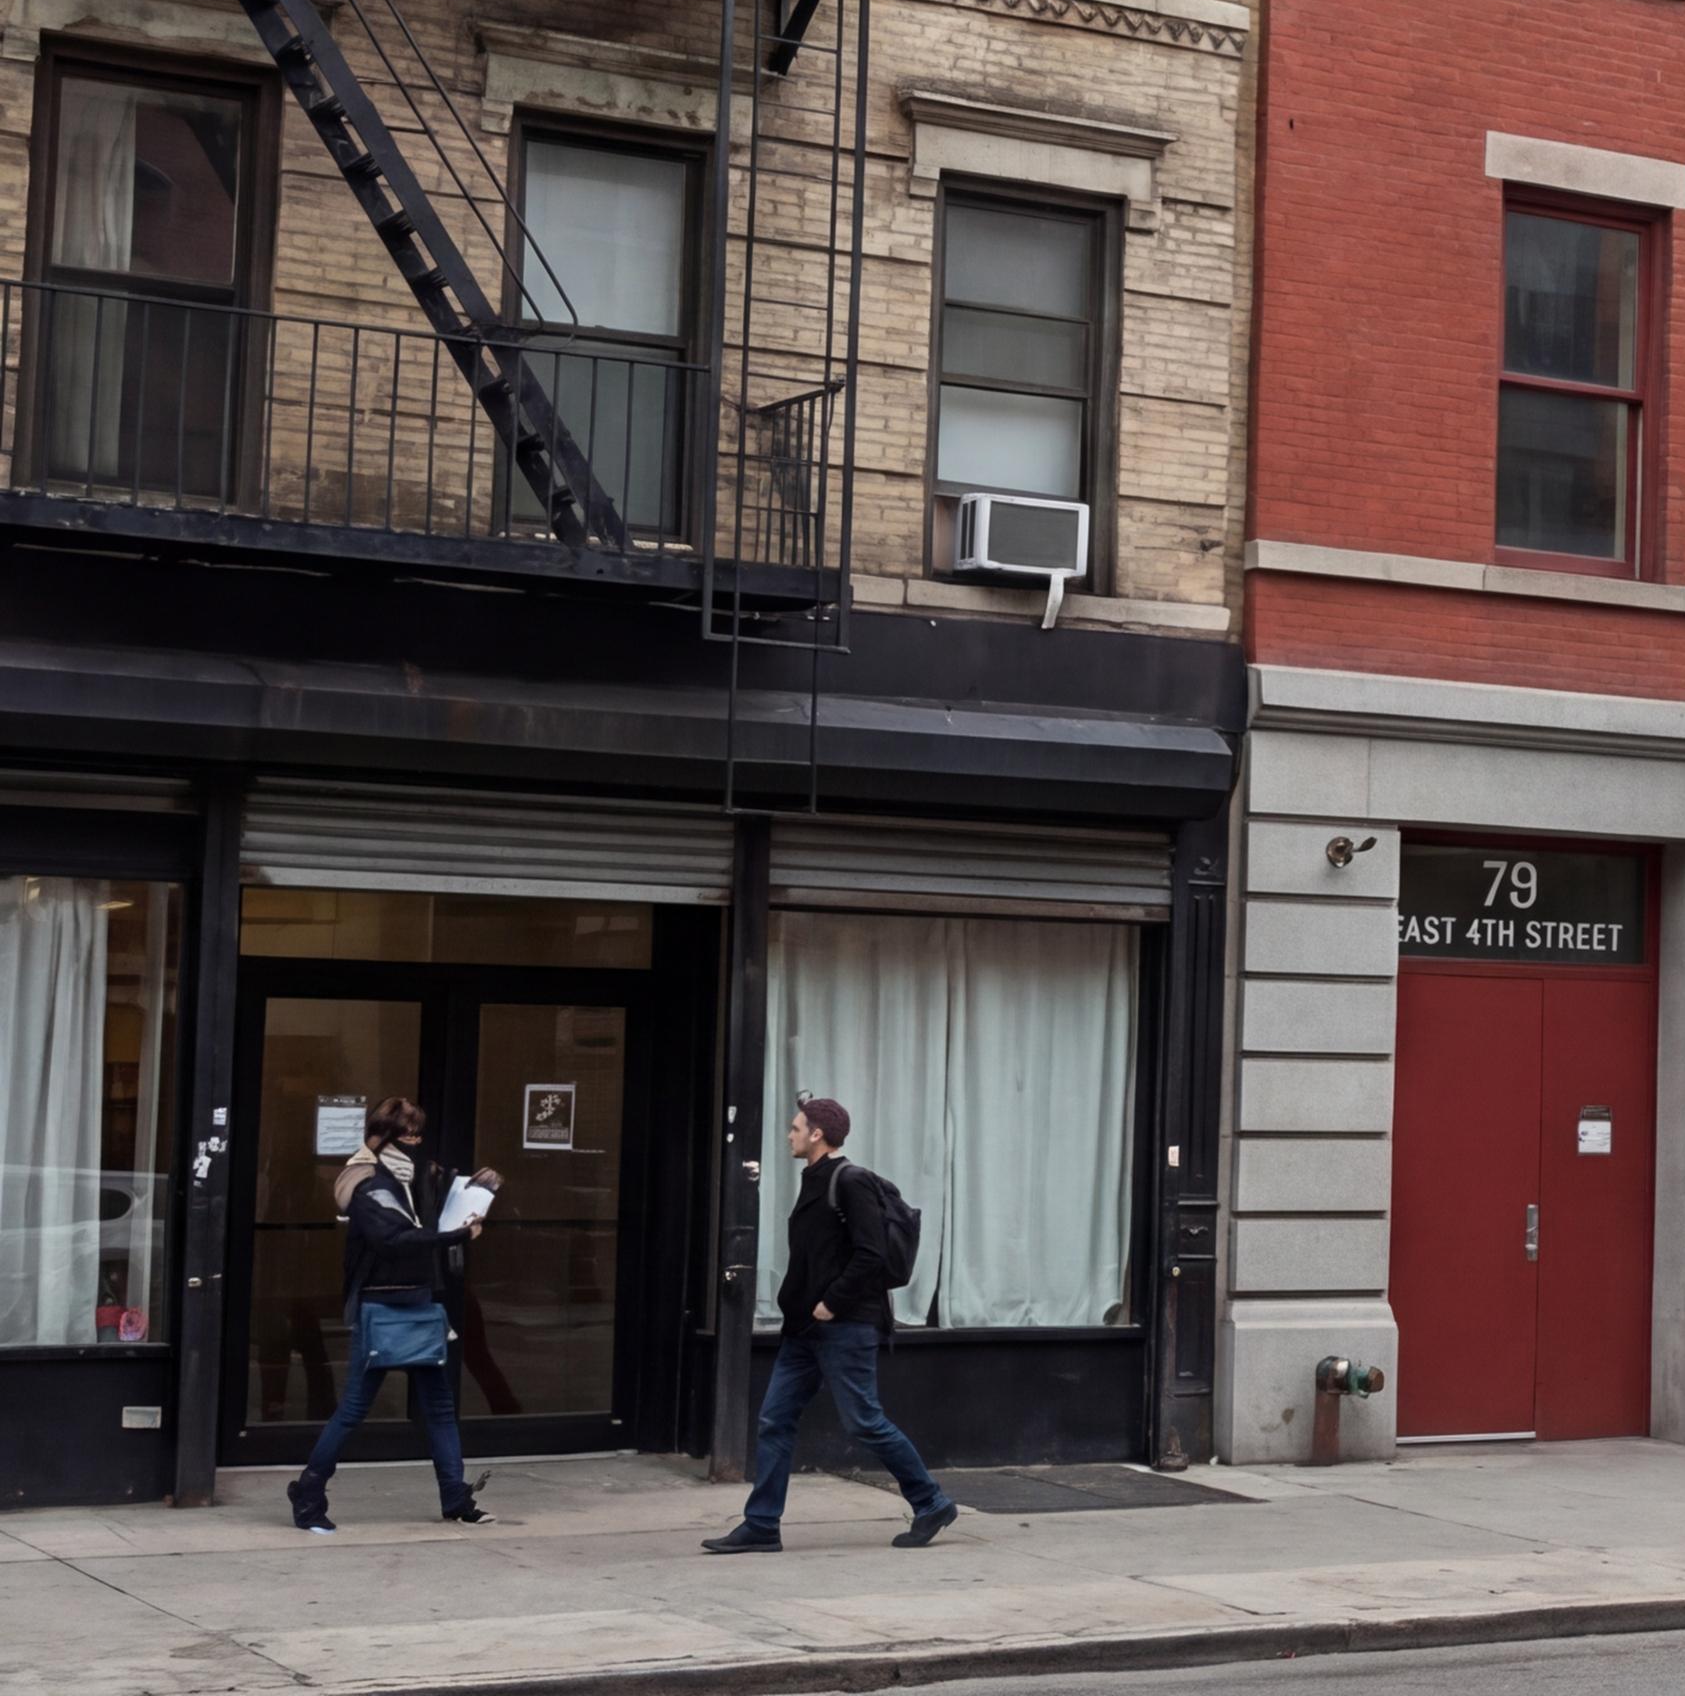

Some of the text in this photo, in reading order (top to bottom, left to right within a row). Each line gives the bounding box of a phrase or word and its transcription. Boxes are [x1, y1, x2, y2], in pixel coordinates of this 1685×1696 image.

[1483, 860, 1538, 909] 79
[1465, 918, 1515, 948] 4TH
[1525, 921, 1623, 952] STREET
